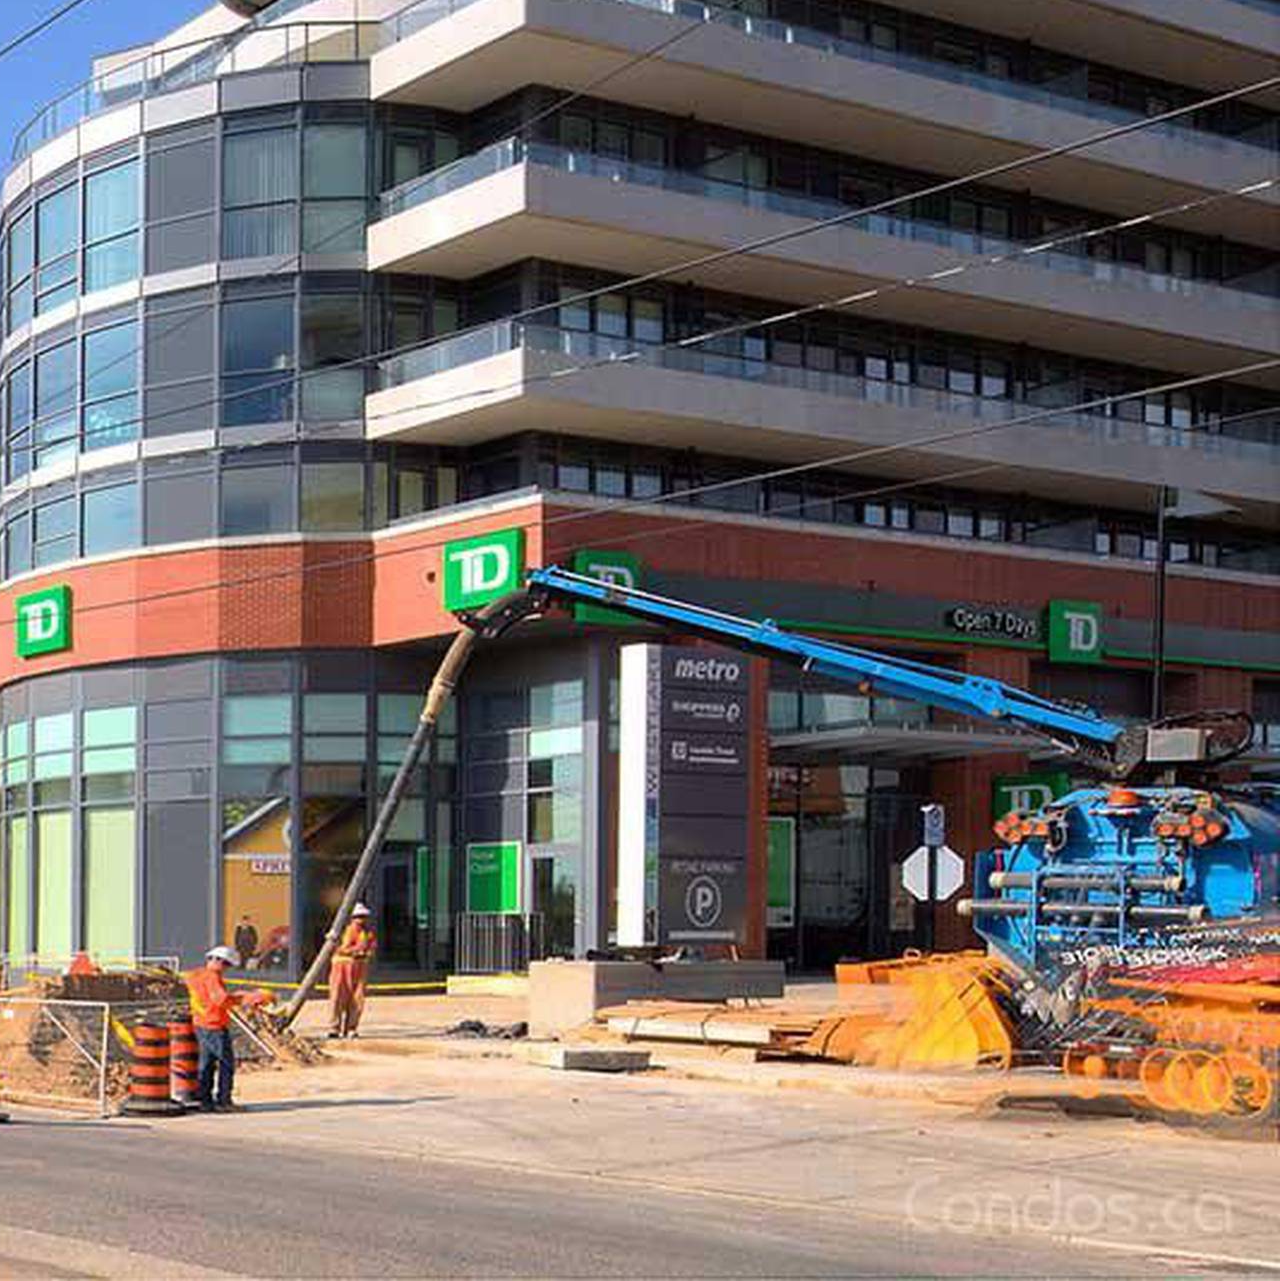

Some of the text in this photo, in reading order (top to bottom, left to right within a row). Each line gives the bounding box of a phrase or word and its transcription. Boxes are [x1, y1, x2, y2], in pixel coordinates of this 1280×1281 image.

[449, 543, 511, 595] TD
[20, 599, 59, 643] TD
[953, 608, 990, 631] Open
[994, 612, 1003, 630] 7
[1064, 611, 1099, 652] TD
[675, 659, 739, 681] metro
[1001, 784, 1053, 814] TD
